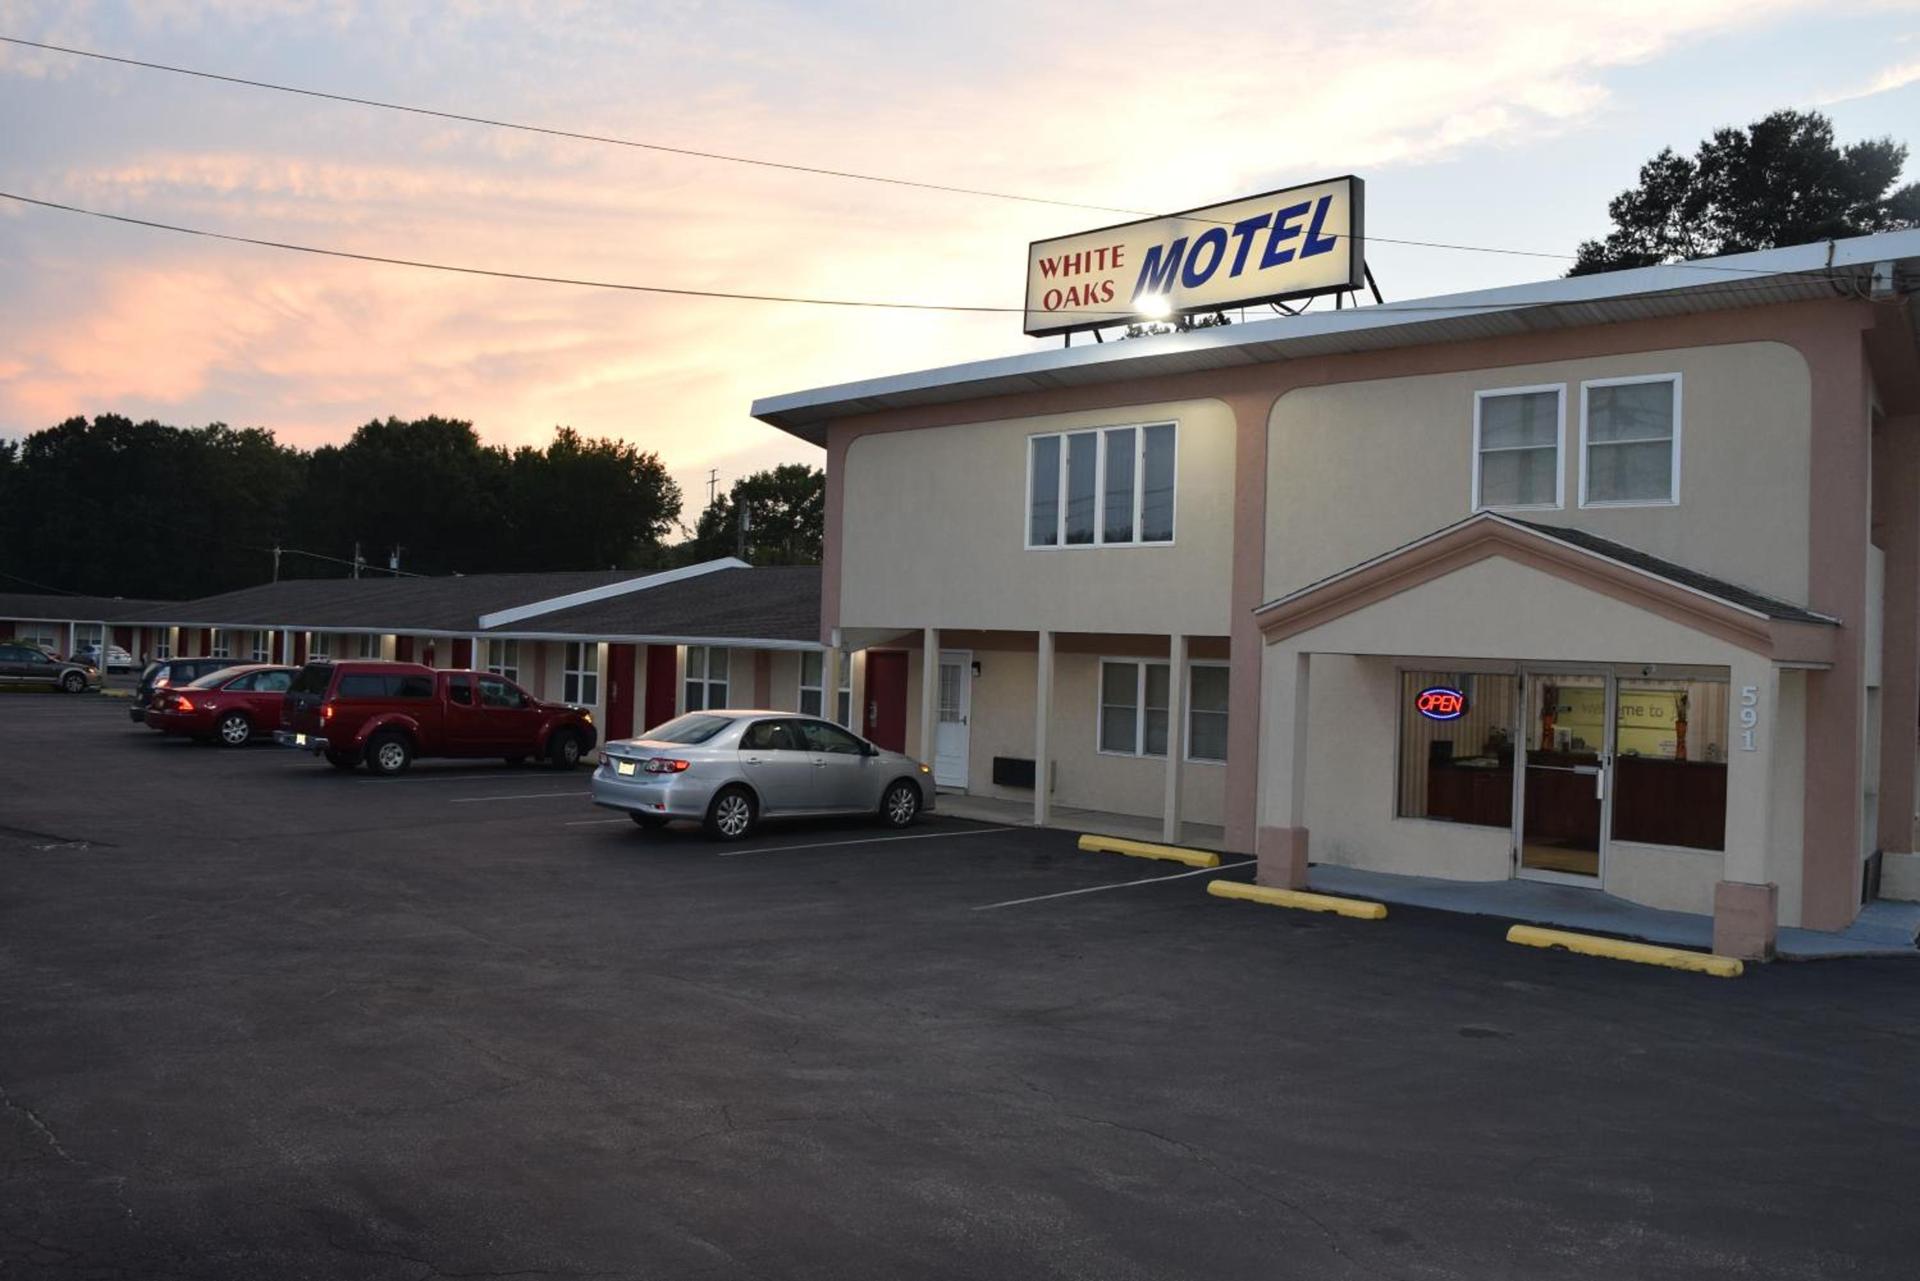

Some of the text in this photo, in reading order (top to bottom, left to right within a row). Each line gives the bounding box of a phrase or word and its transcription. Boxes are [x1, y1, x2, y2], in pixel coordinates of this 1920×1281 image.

[1039, 244, 1125, 279] WHITE
[1130, 194, 1337, 304] MOTEL
[1043, 280, 1115, 312] OAKS
[1418, 694, 1463, 713] OPEN
[1649, 703, 1664, 717] to
[1740, 686, 1758, 751] 591
